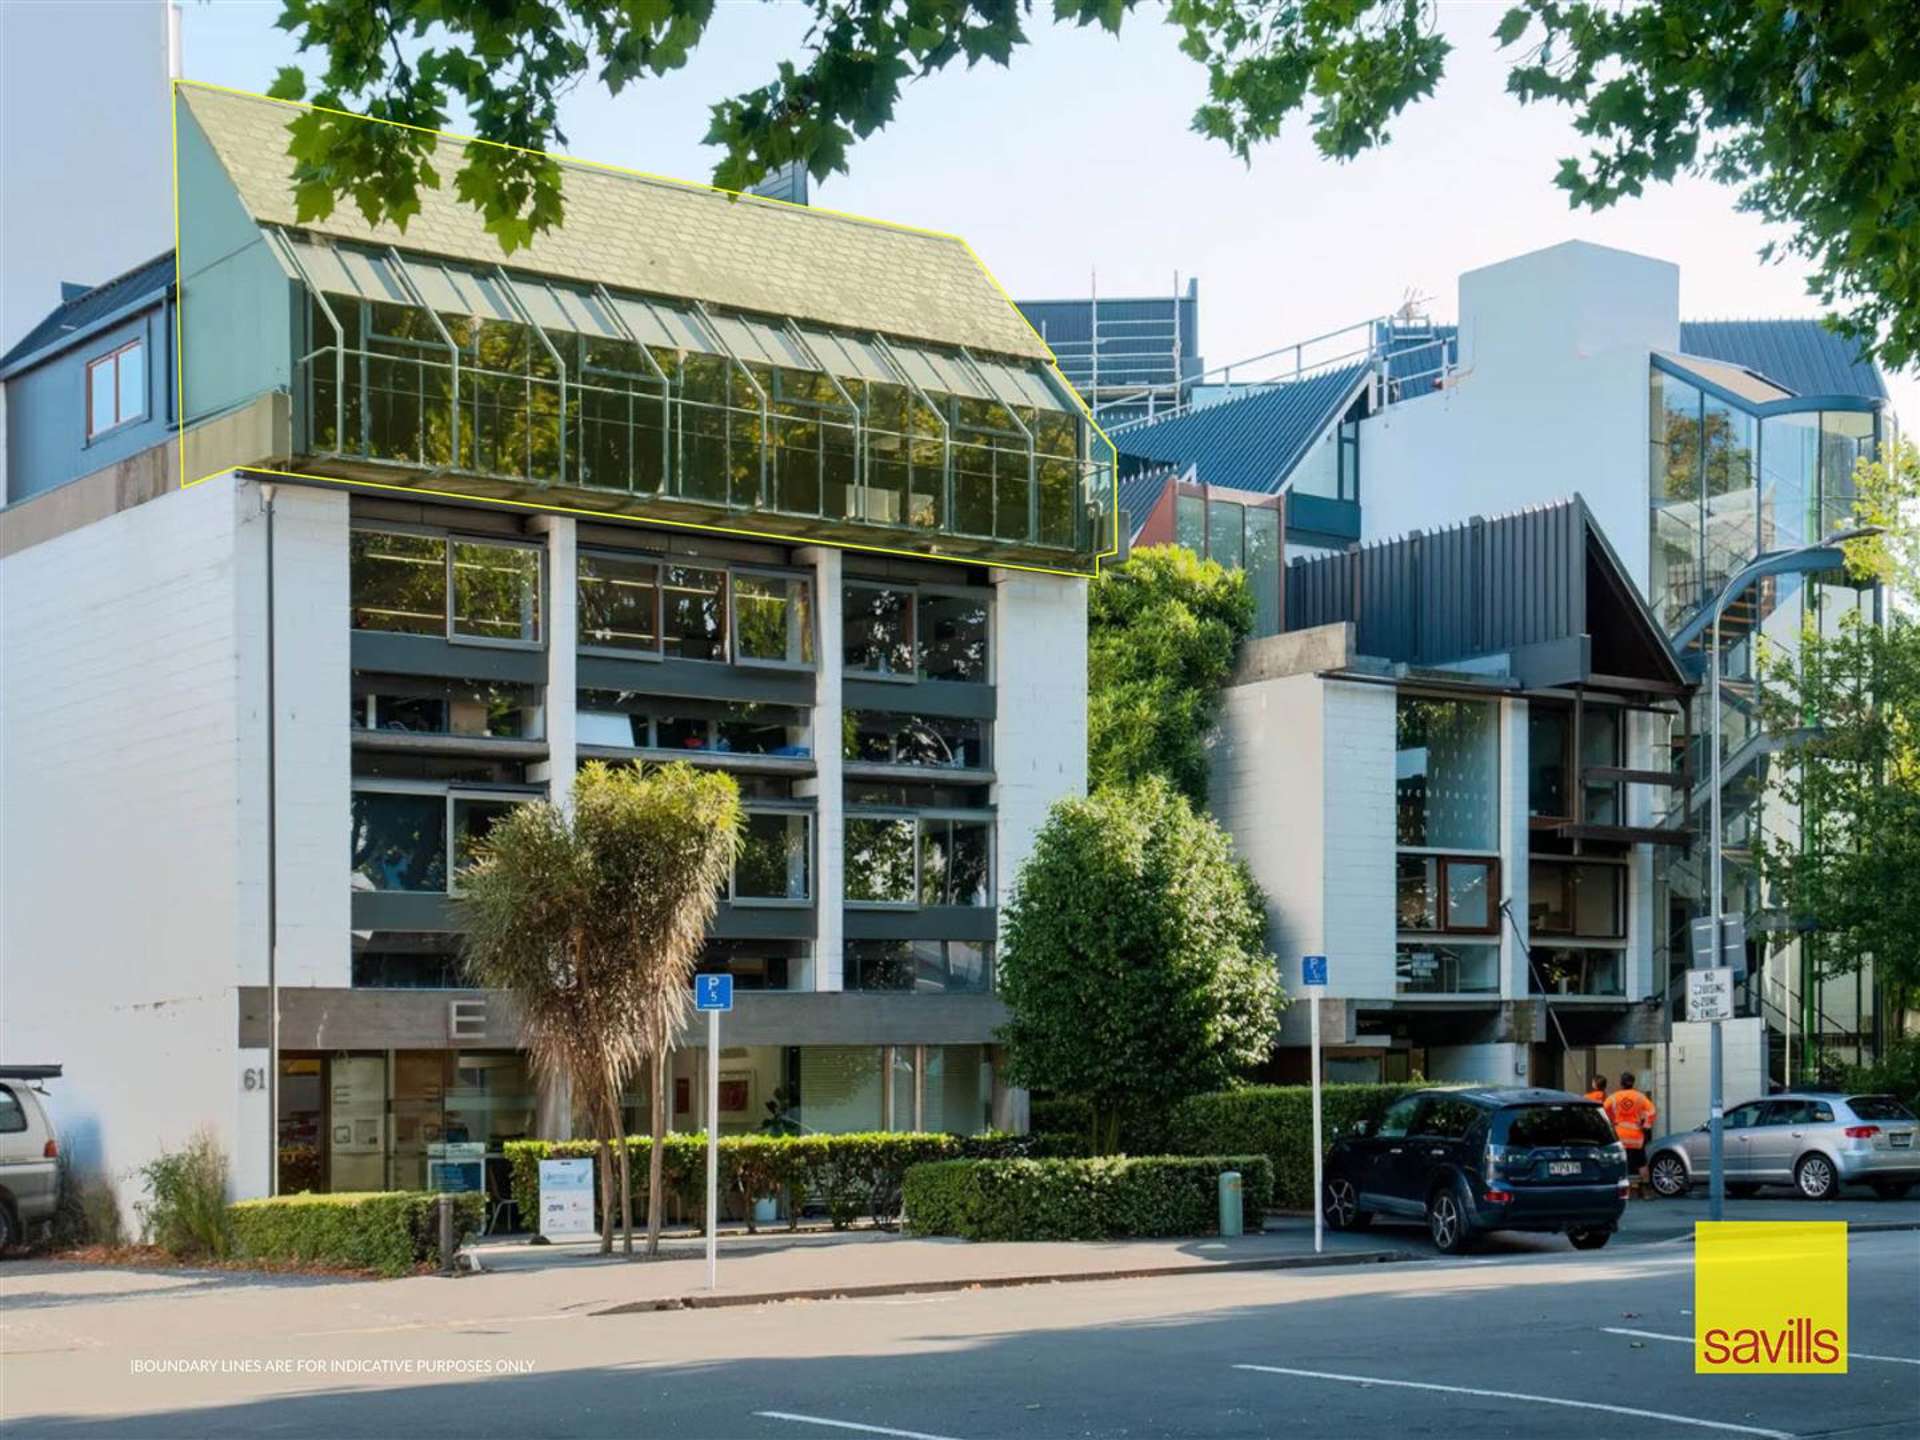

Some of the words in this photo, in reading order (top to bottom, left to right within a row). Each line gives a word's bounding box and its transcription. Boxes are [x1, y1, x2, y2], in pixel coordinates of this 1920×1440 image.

[708, 977, 720, 990] P
[711, 991, 718, 1002] 5
[243, 1067, 266, 1090] 61
